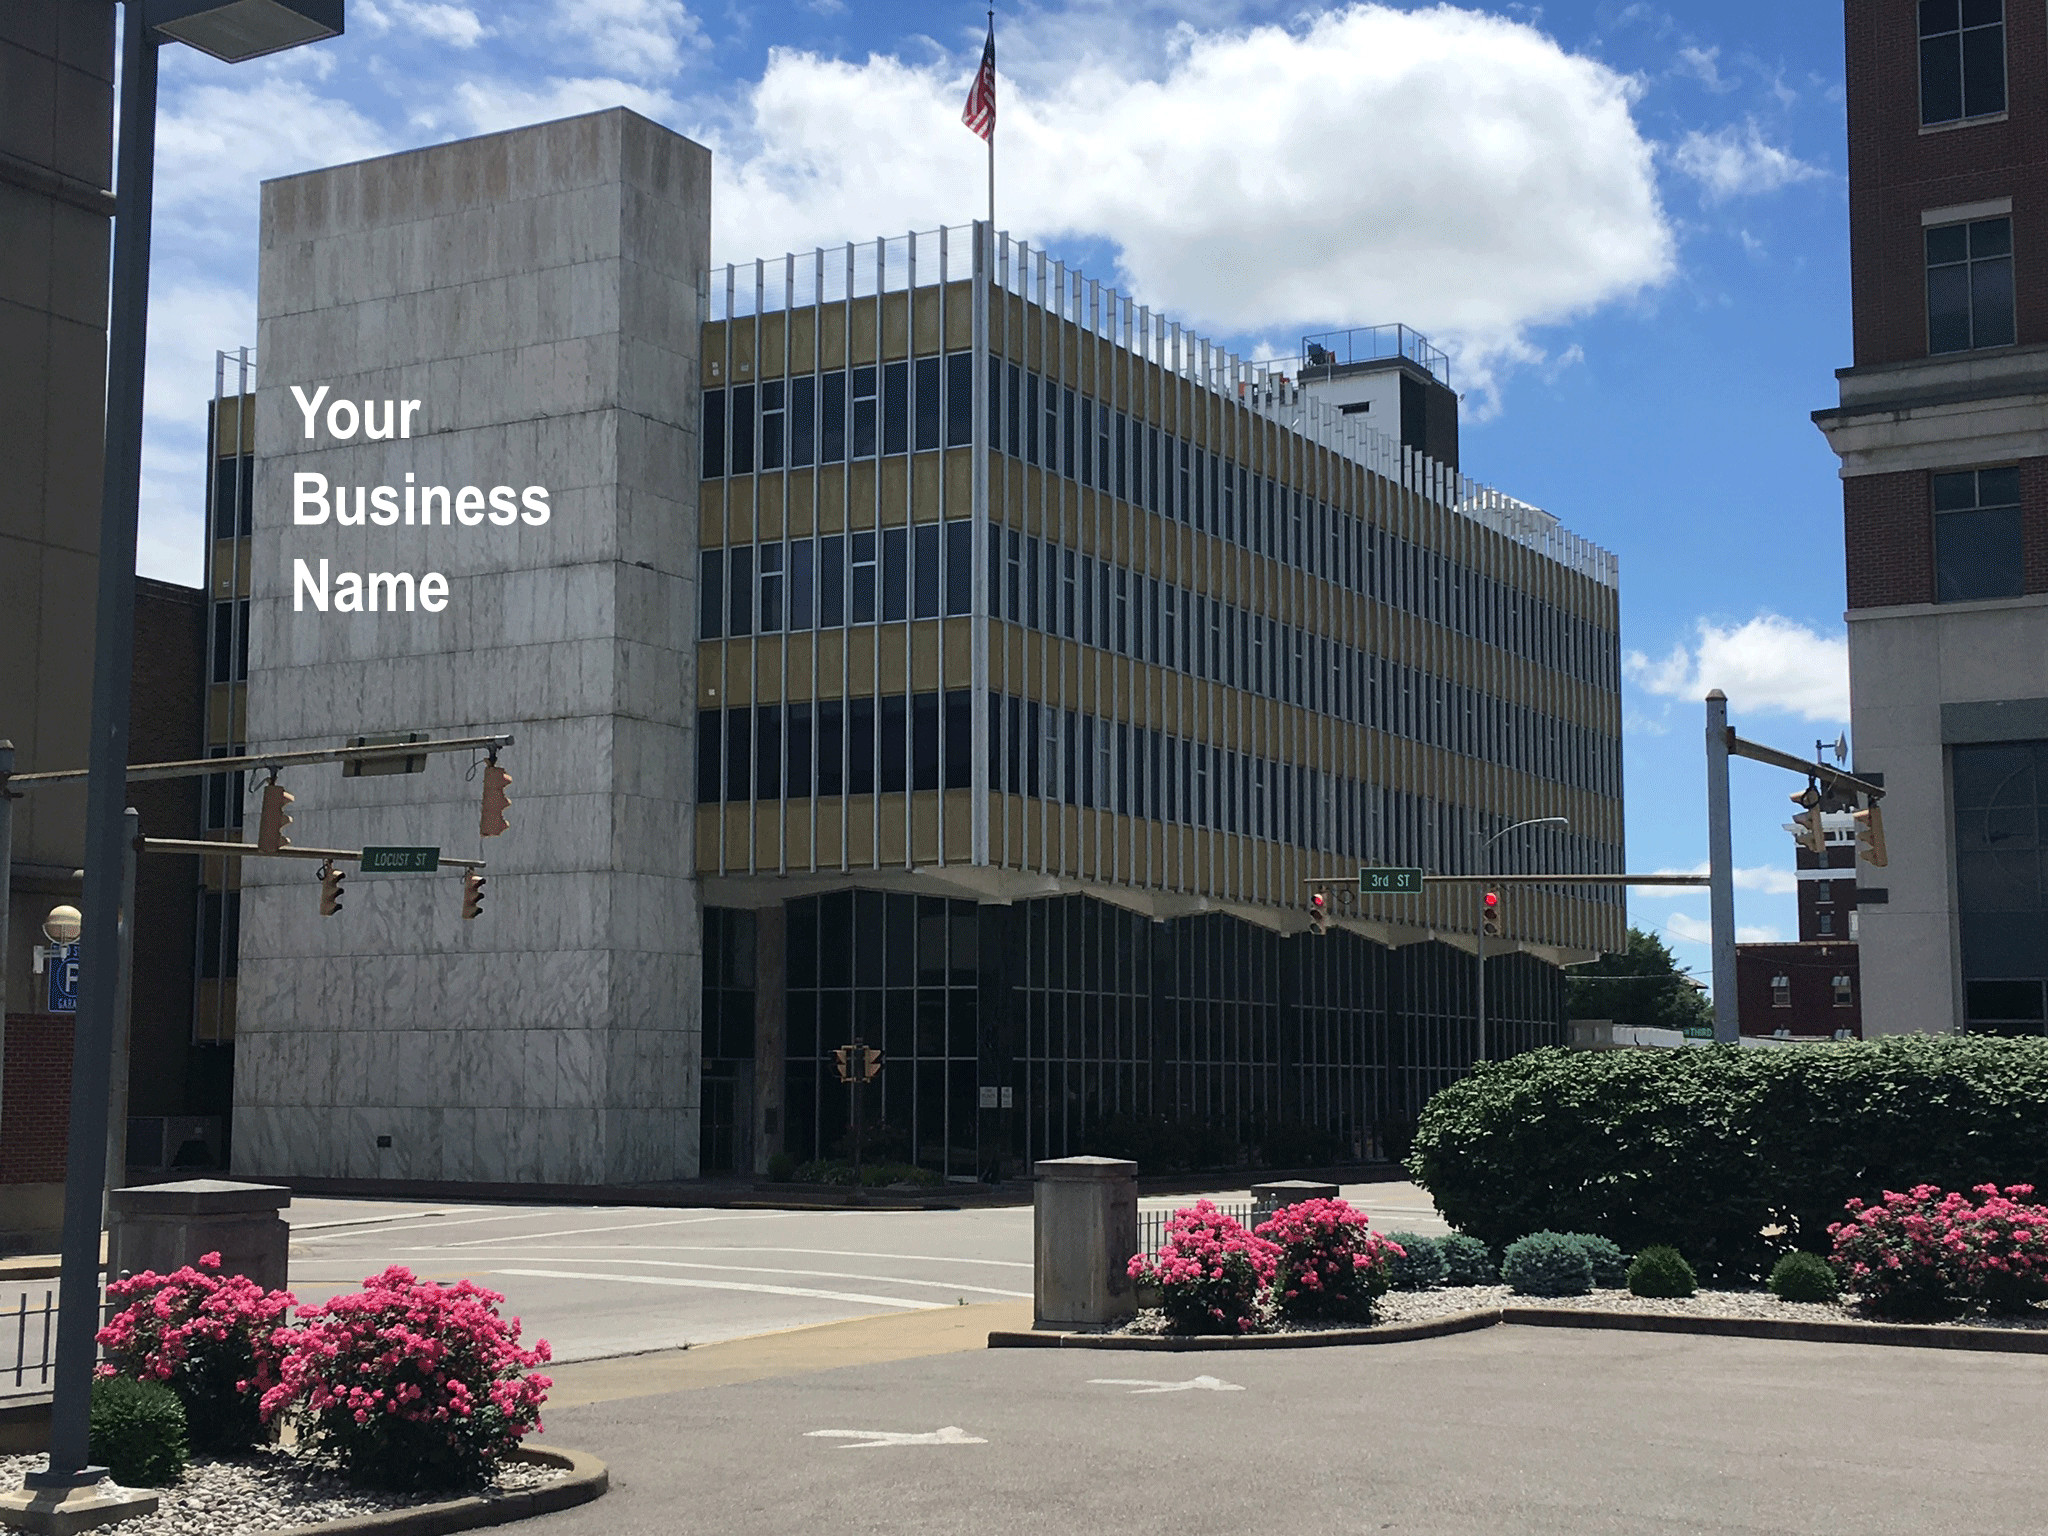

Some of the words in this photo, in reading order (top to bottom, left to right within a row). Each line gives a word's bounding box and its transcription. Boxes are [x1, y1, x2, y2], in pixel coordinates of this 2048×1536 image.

[374, 853, 409, 866] LOCUST
[415, 853, 427, 866] ST
[1371, 874, 1389, 887] 3rd
[1397, 874, 1410, 887] ST
[1690, 1027, 1713, 1037] THIRD
